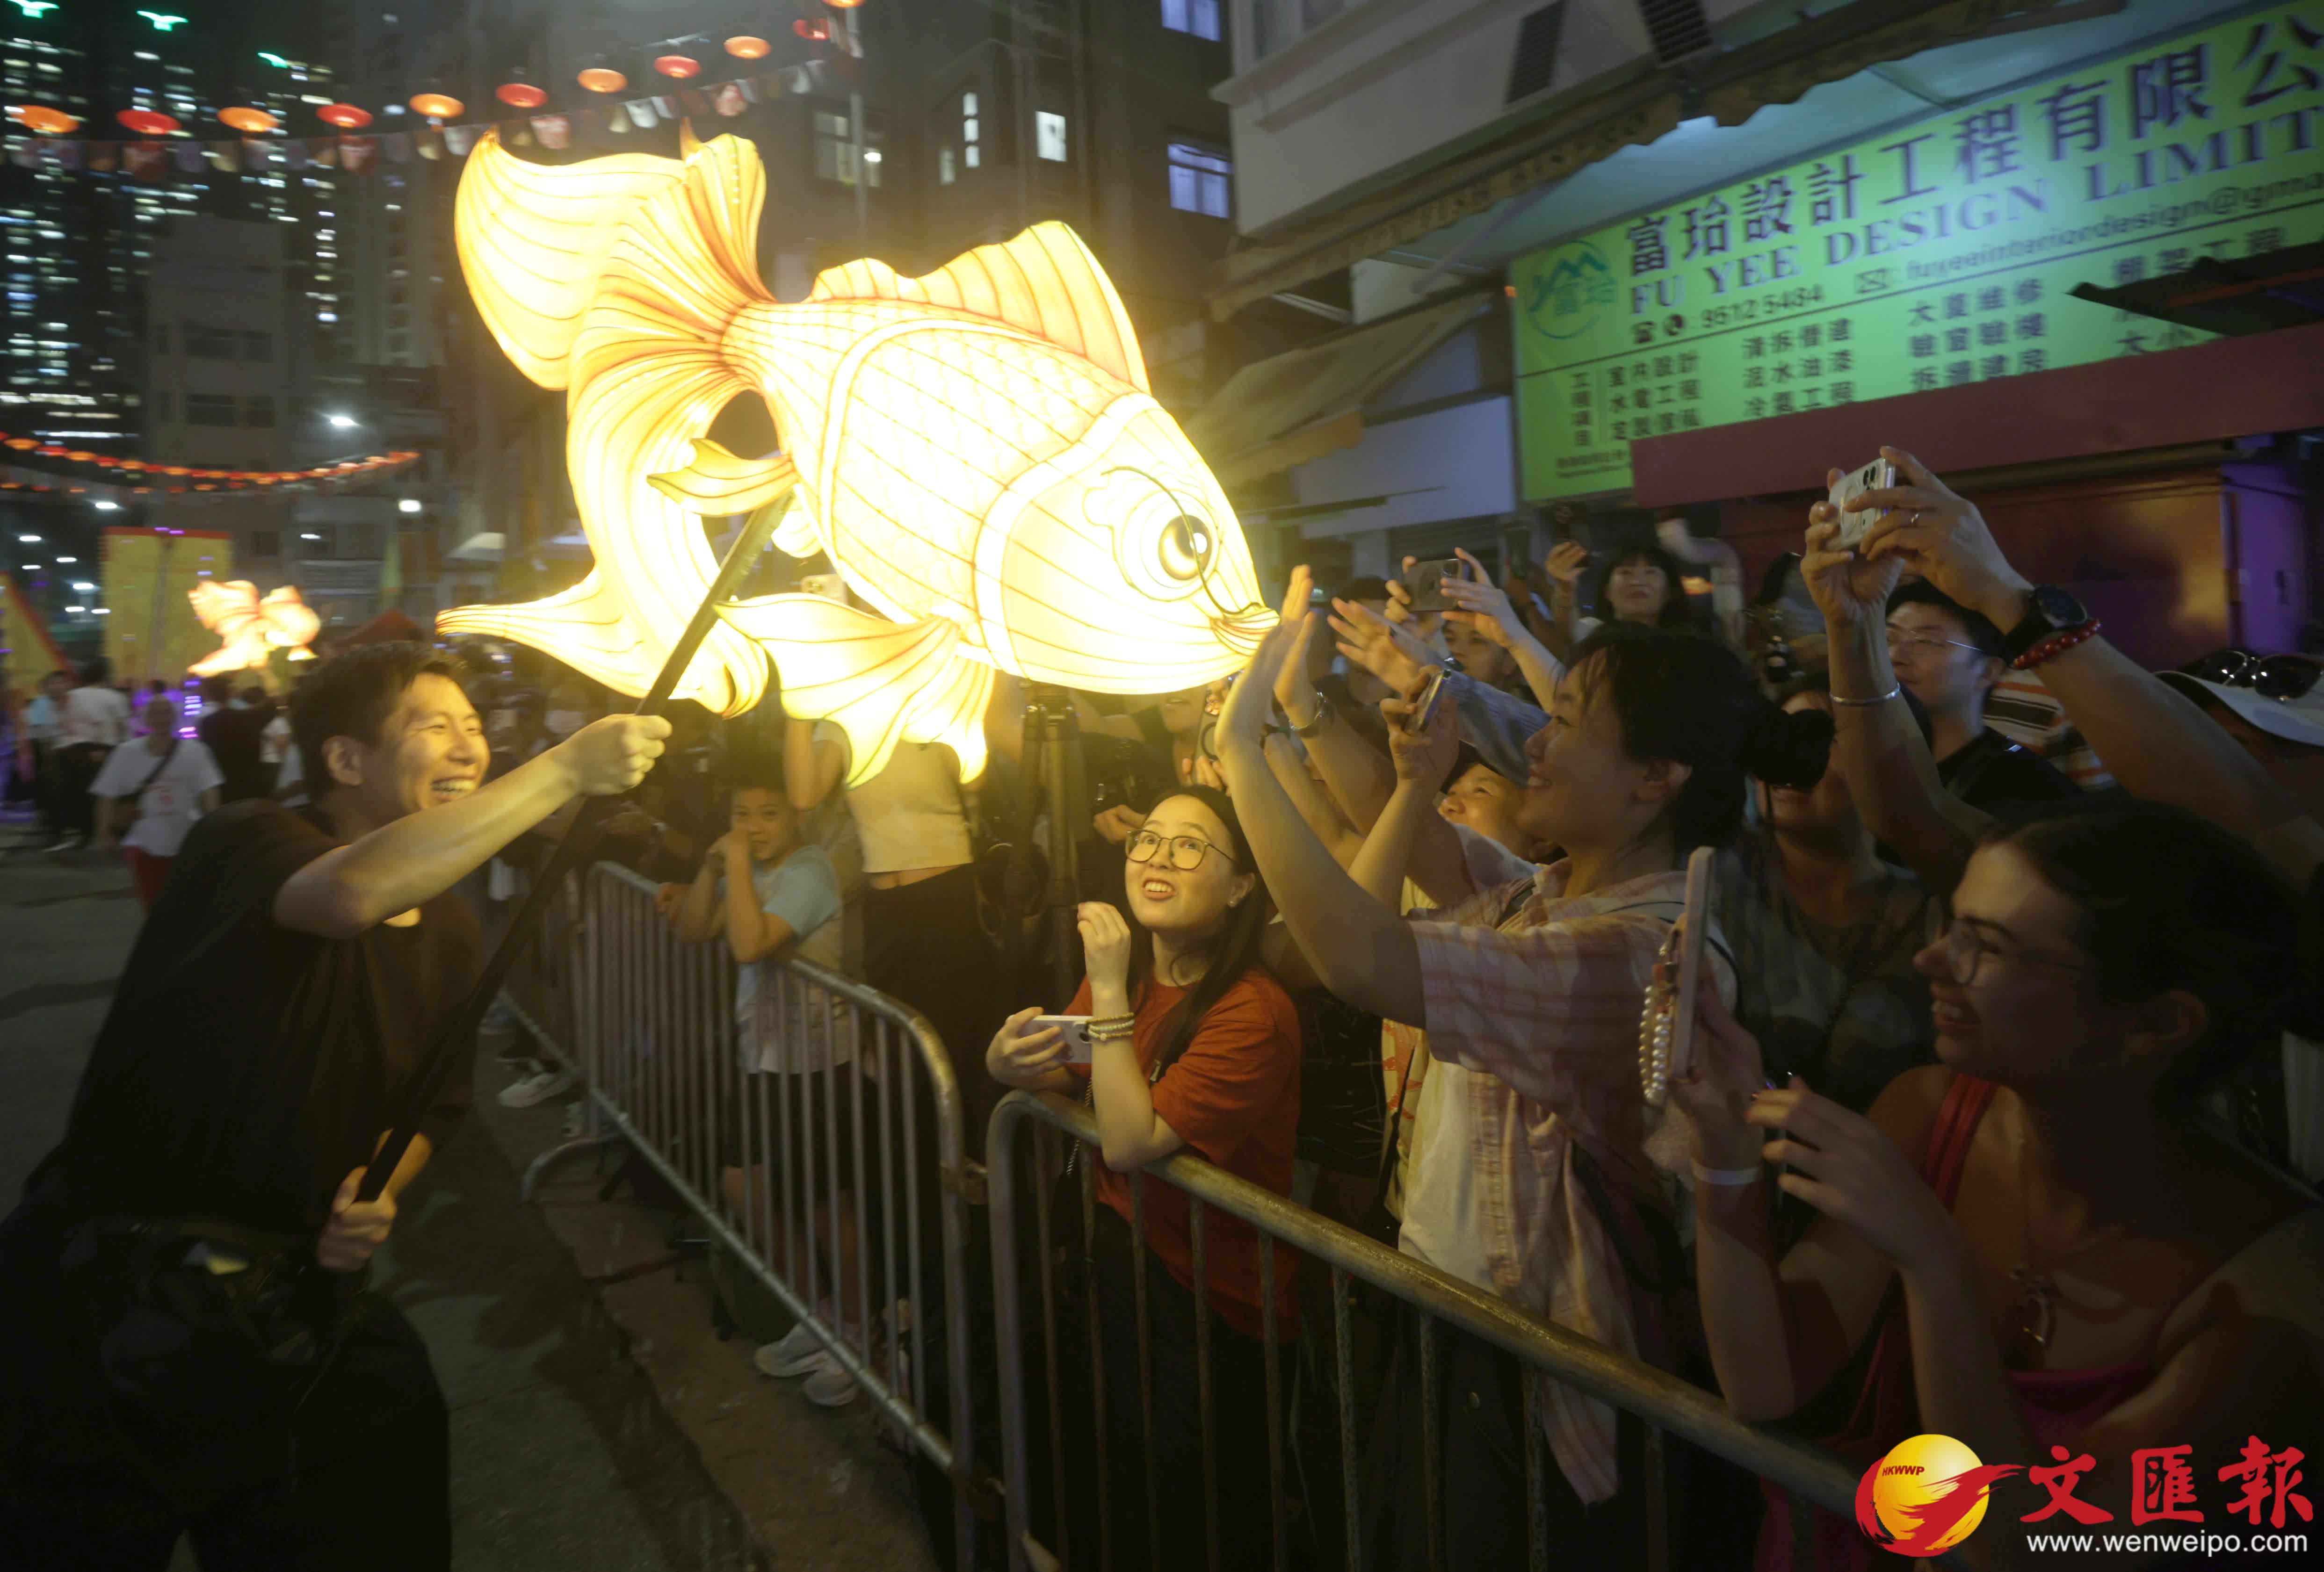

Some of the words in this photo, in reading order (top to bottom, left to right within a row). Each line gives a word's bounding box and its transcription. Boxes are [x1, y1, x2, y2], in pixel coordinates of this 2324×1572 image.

[1629, 276, 1684, 314] FU
[1704, 245, 1802, 296] YEE
[1824, 179, 2052, 267] DESIGN
[2082, 105, 2324, 202] LIMIT
[1907, 278, 2045, 325] 大廈維修
[1744, 348, 1853, 389] 泥水油漆
[1609, 378, 1701, 414] 水電工程
[1745, 380, 1855, 418] 冷氣工程
